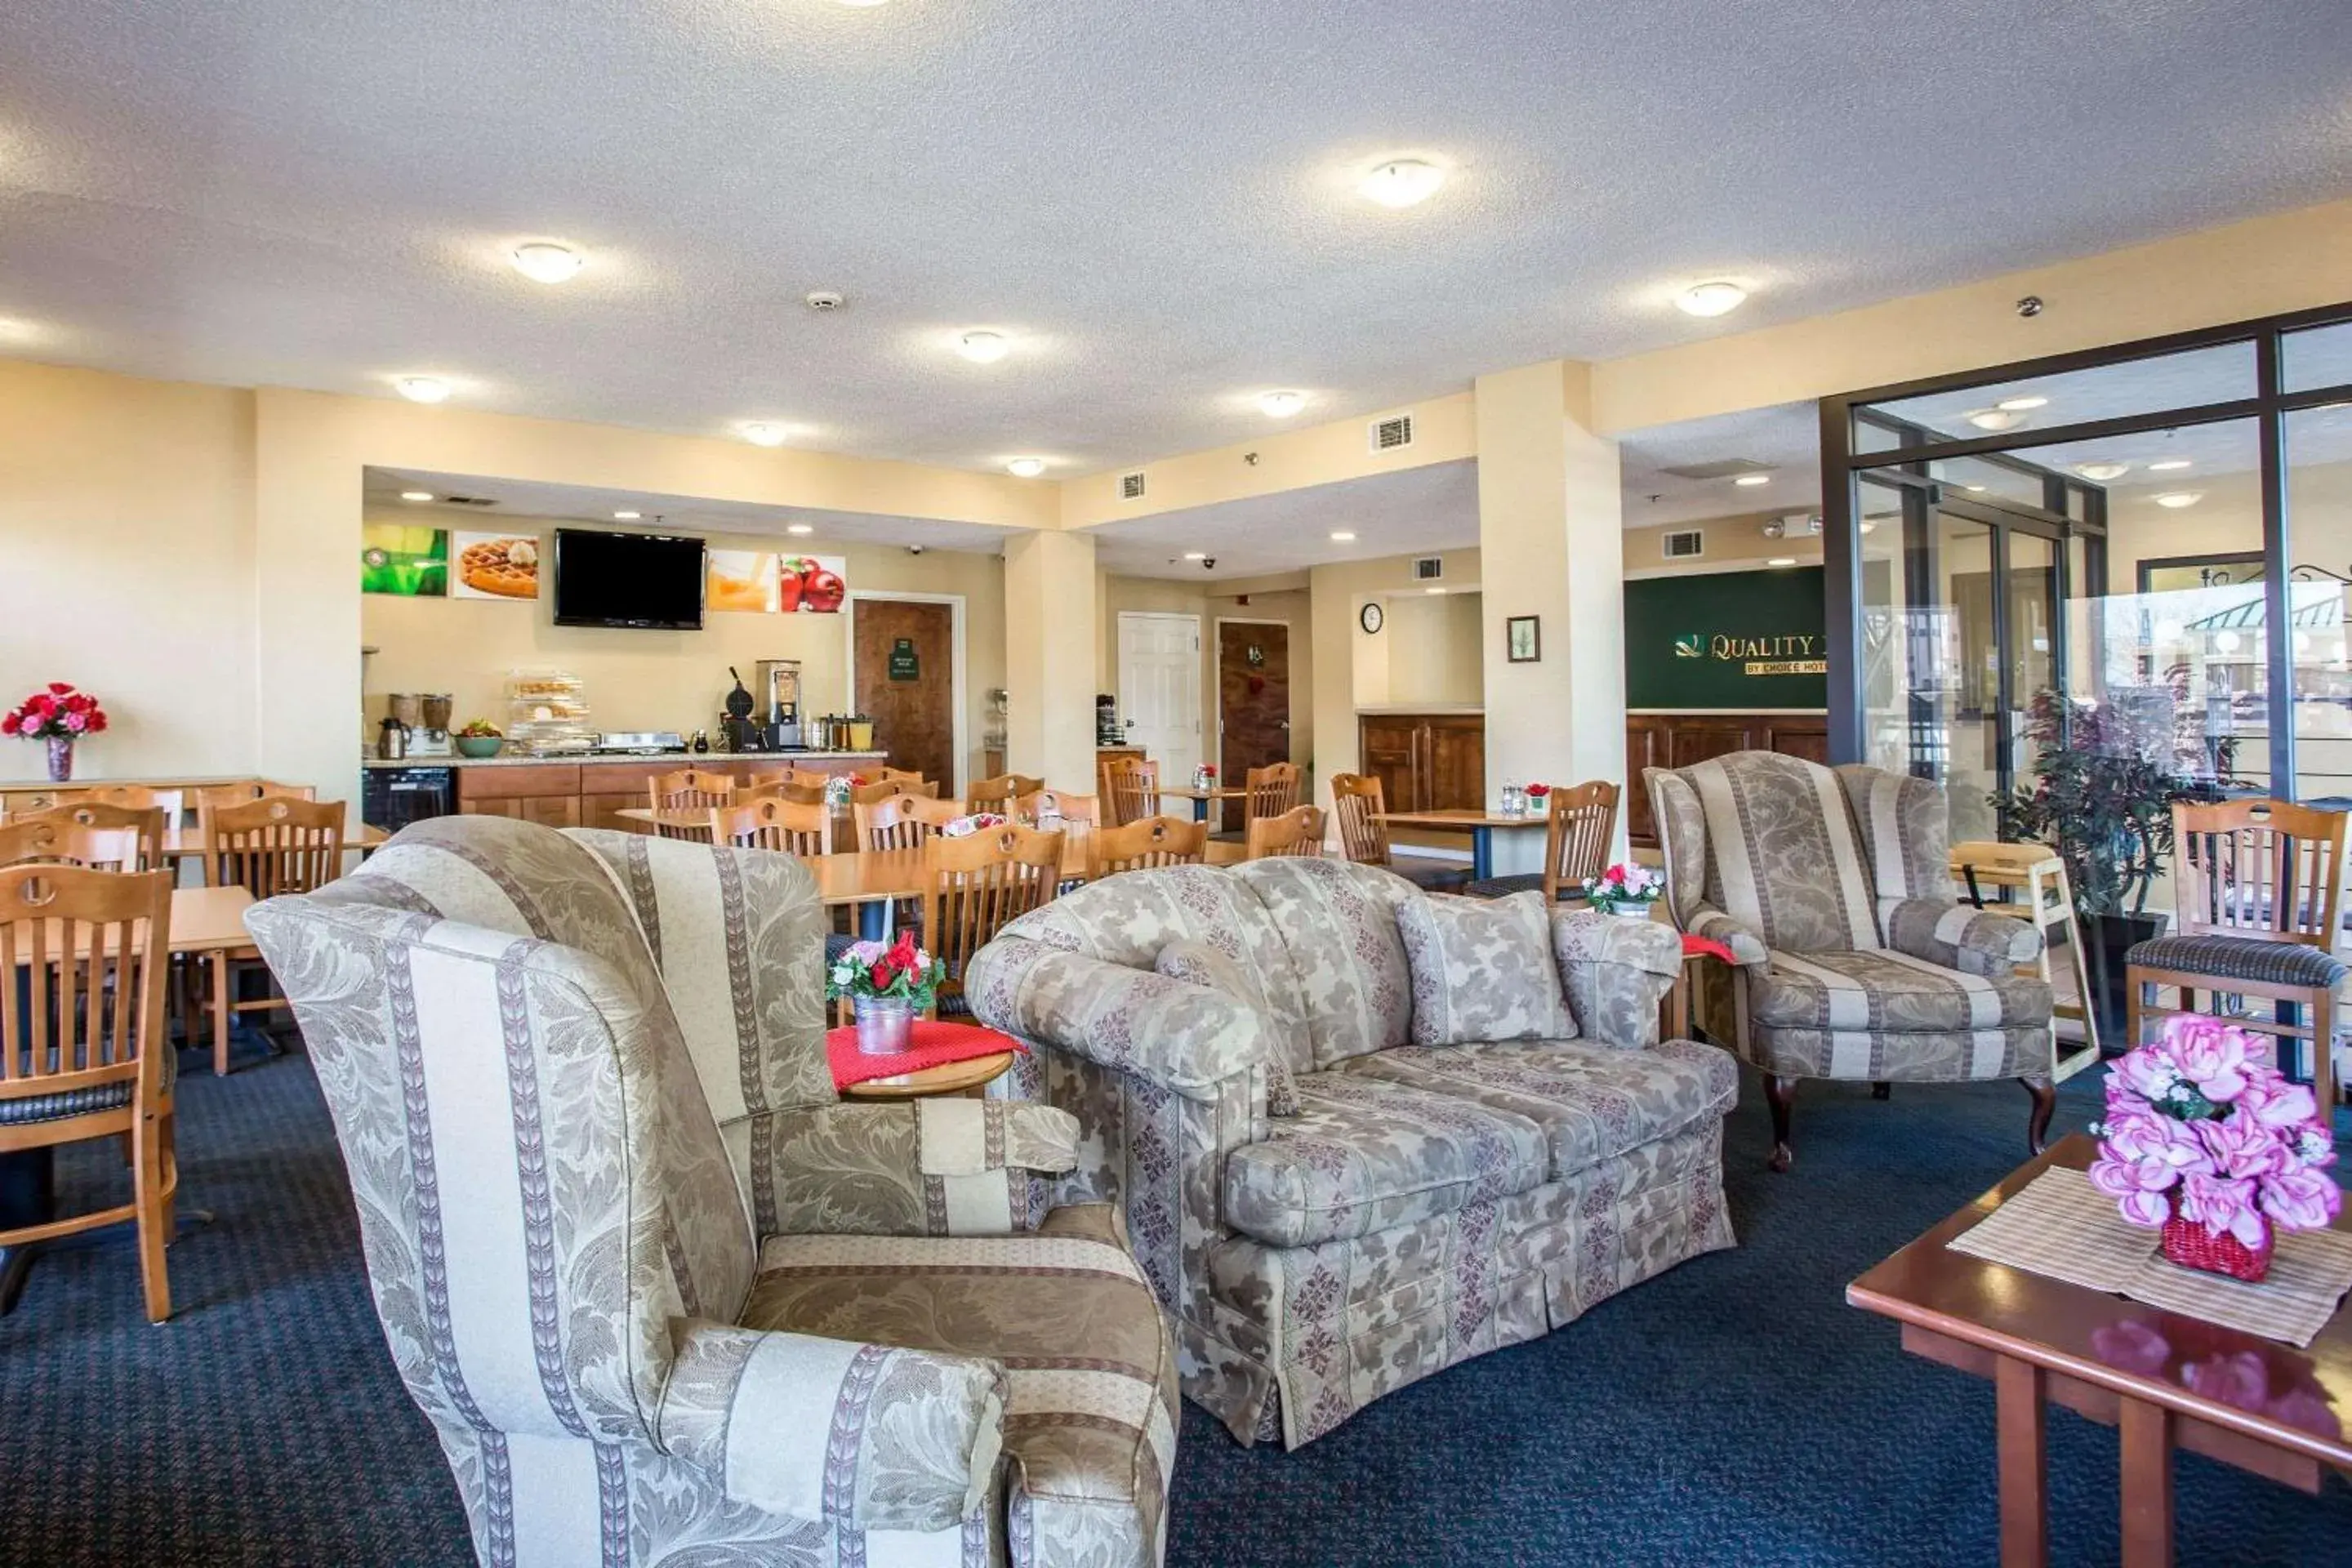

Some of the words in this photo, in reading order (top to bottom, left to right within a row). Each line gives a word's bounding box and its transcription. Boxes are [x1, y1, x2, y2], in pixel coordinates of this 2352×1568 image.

[1712, 635, 1813, 659] QUALITY
[1748, 664, 1759, 673] BY
[1763, 663, 1800, 673] CHOICE
